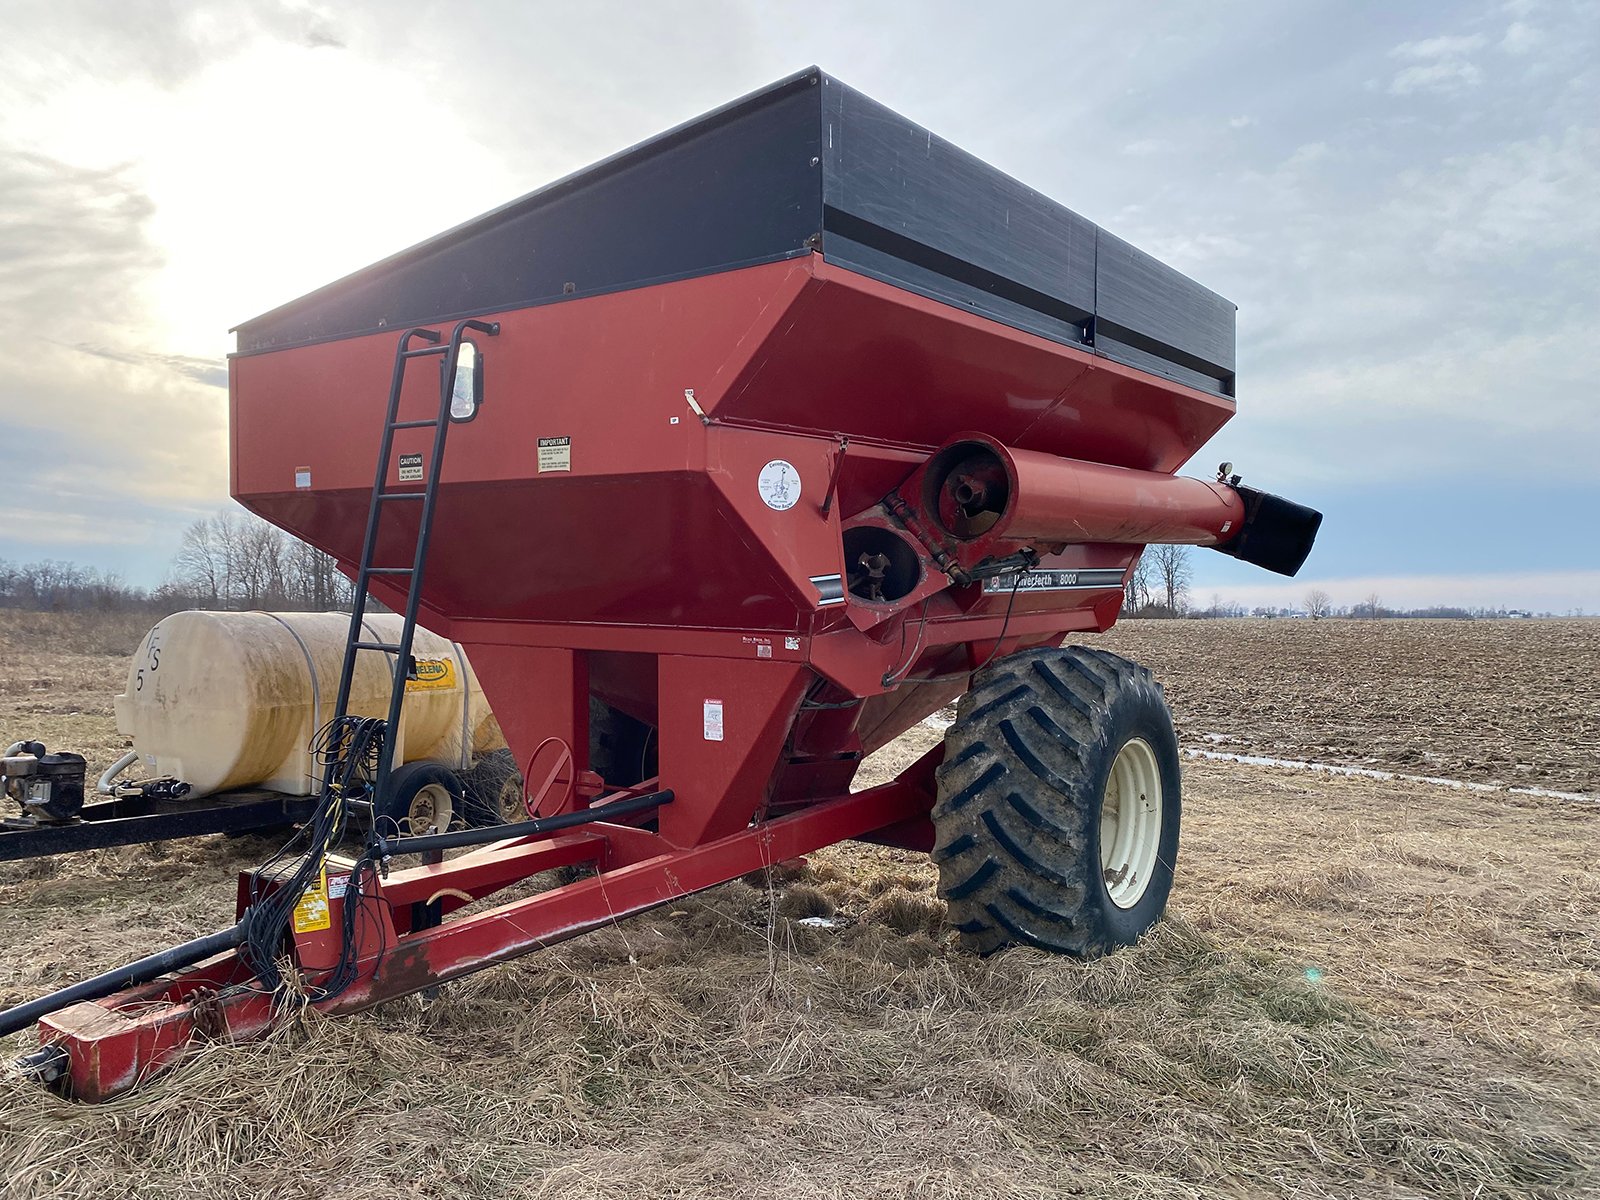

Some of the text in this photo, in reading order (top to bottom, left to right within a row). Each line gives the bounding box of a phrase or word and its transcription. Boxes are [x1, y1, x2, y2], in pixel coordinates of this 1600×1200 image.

[540, 437, 569, 446] IMPORTANT
[400, 457, 421, 465] CAUTION
[1060, 574, 1077, 585] 8000
[136, 669, 145, 692] 5
